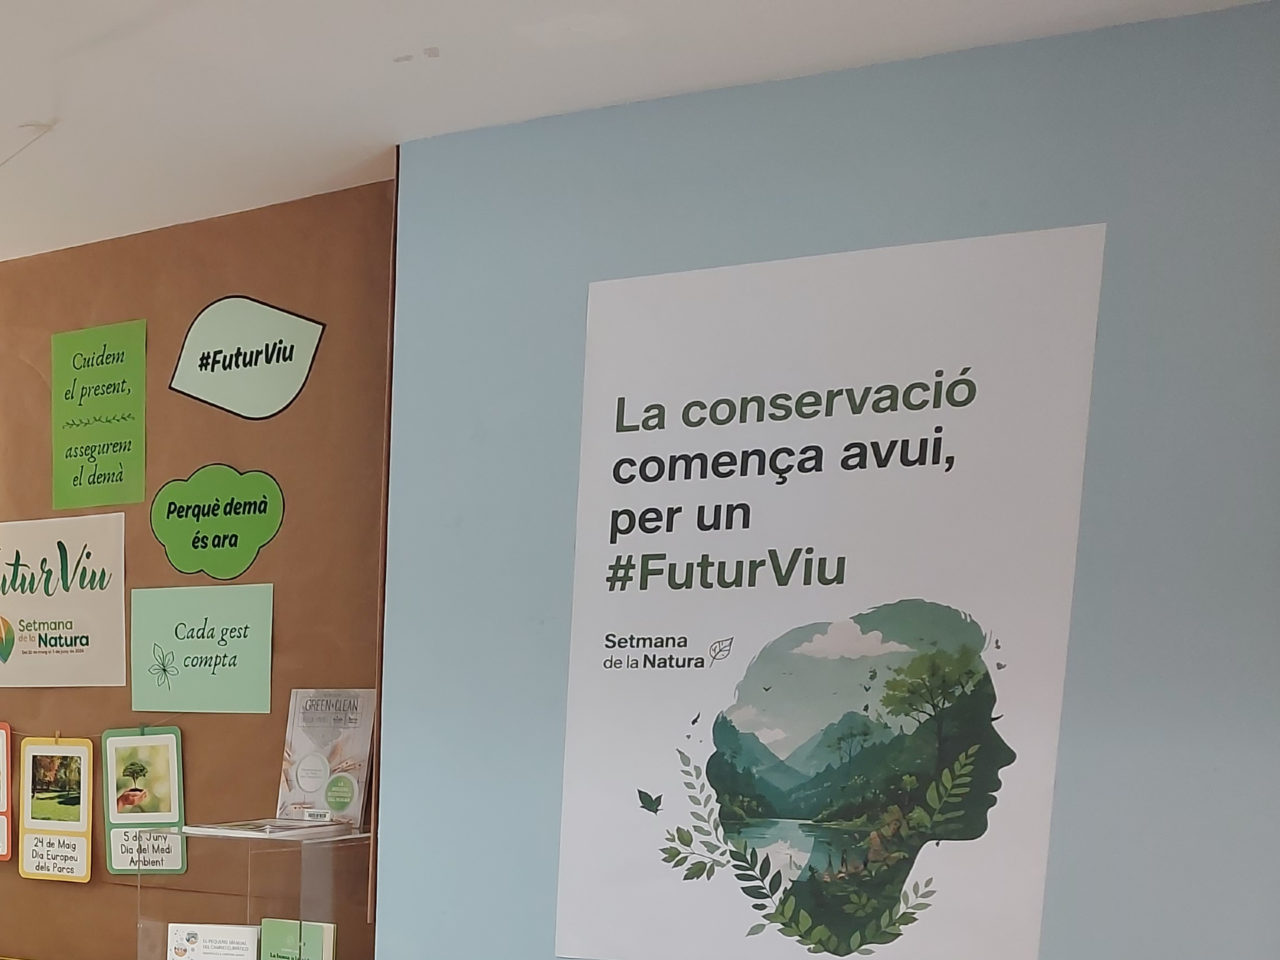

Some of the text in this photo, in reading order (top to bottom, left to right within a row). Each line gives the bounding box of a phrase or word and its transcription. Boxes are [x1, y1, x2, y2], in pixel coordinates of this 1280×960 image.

[72, 344, 125, 370] Cuidem
[198, 339, 294, 373] #FuturViu
[65, 378, 131, 406] el present,
[615, 366, 977, 433] La conservació
[65, 438, 132, 463] assegurem
[612, 425, 956, 486] comença avui,
[73, 462, 124, 487] el demà
[166, 494, 268, 522] Perquè demà
[609, 501, 751, 544] per un
[192, 529, 239, 549] és ara
[606, 547, 847, 591] #FuturViu
[18, 619, 73, 632] Setmana
[174, 617, 250, 646] Cada gest
[18, 633, 89, 648] de la Natura
[604, 634, 688, 650] Setmana
[183, 653, 237, 675] compta
[603, 655, 705, 669] de la Natura
[34, 838, 76, 851] 24 de Maig
[120, 844, 172, 854] Dia del Medi
[123, 832, 168, 844] 5 de Juny
[32, 850, 78, 864] Dia Europeu
[35, 862, 74, 874] dels Parcs
[129, 857, 165, 867] Ambient
